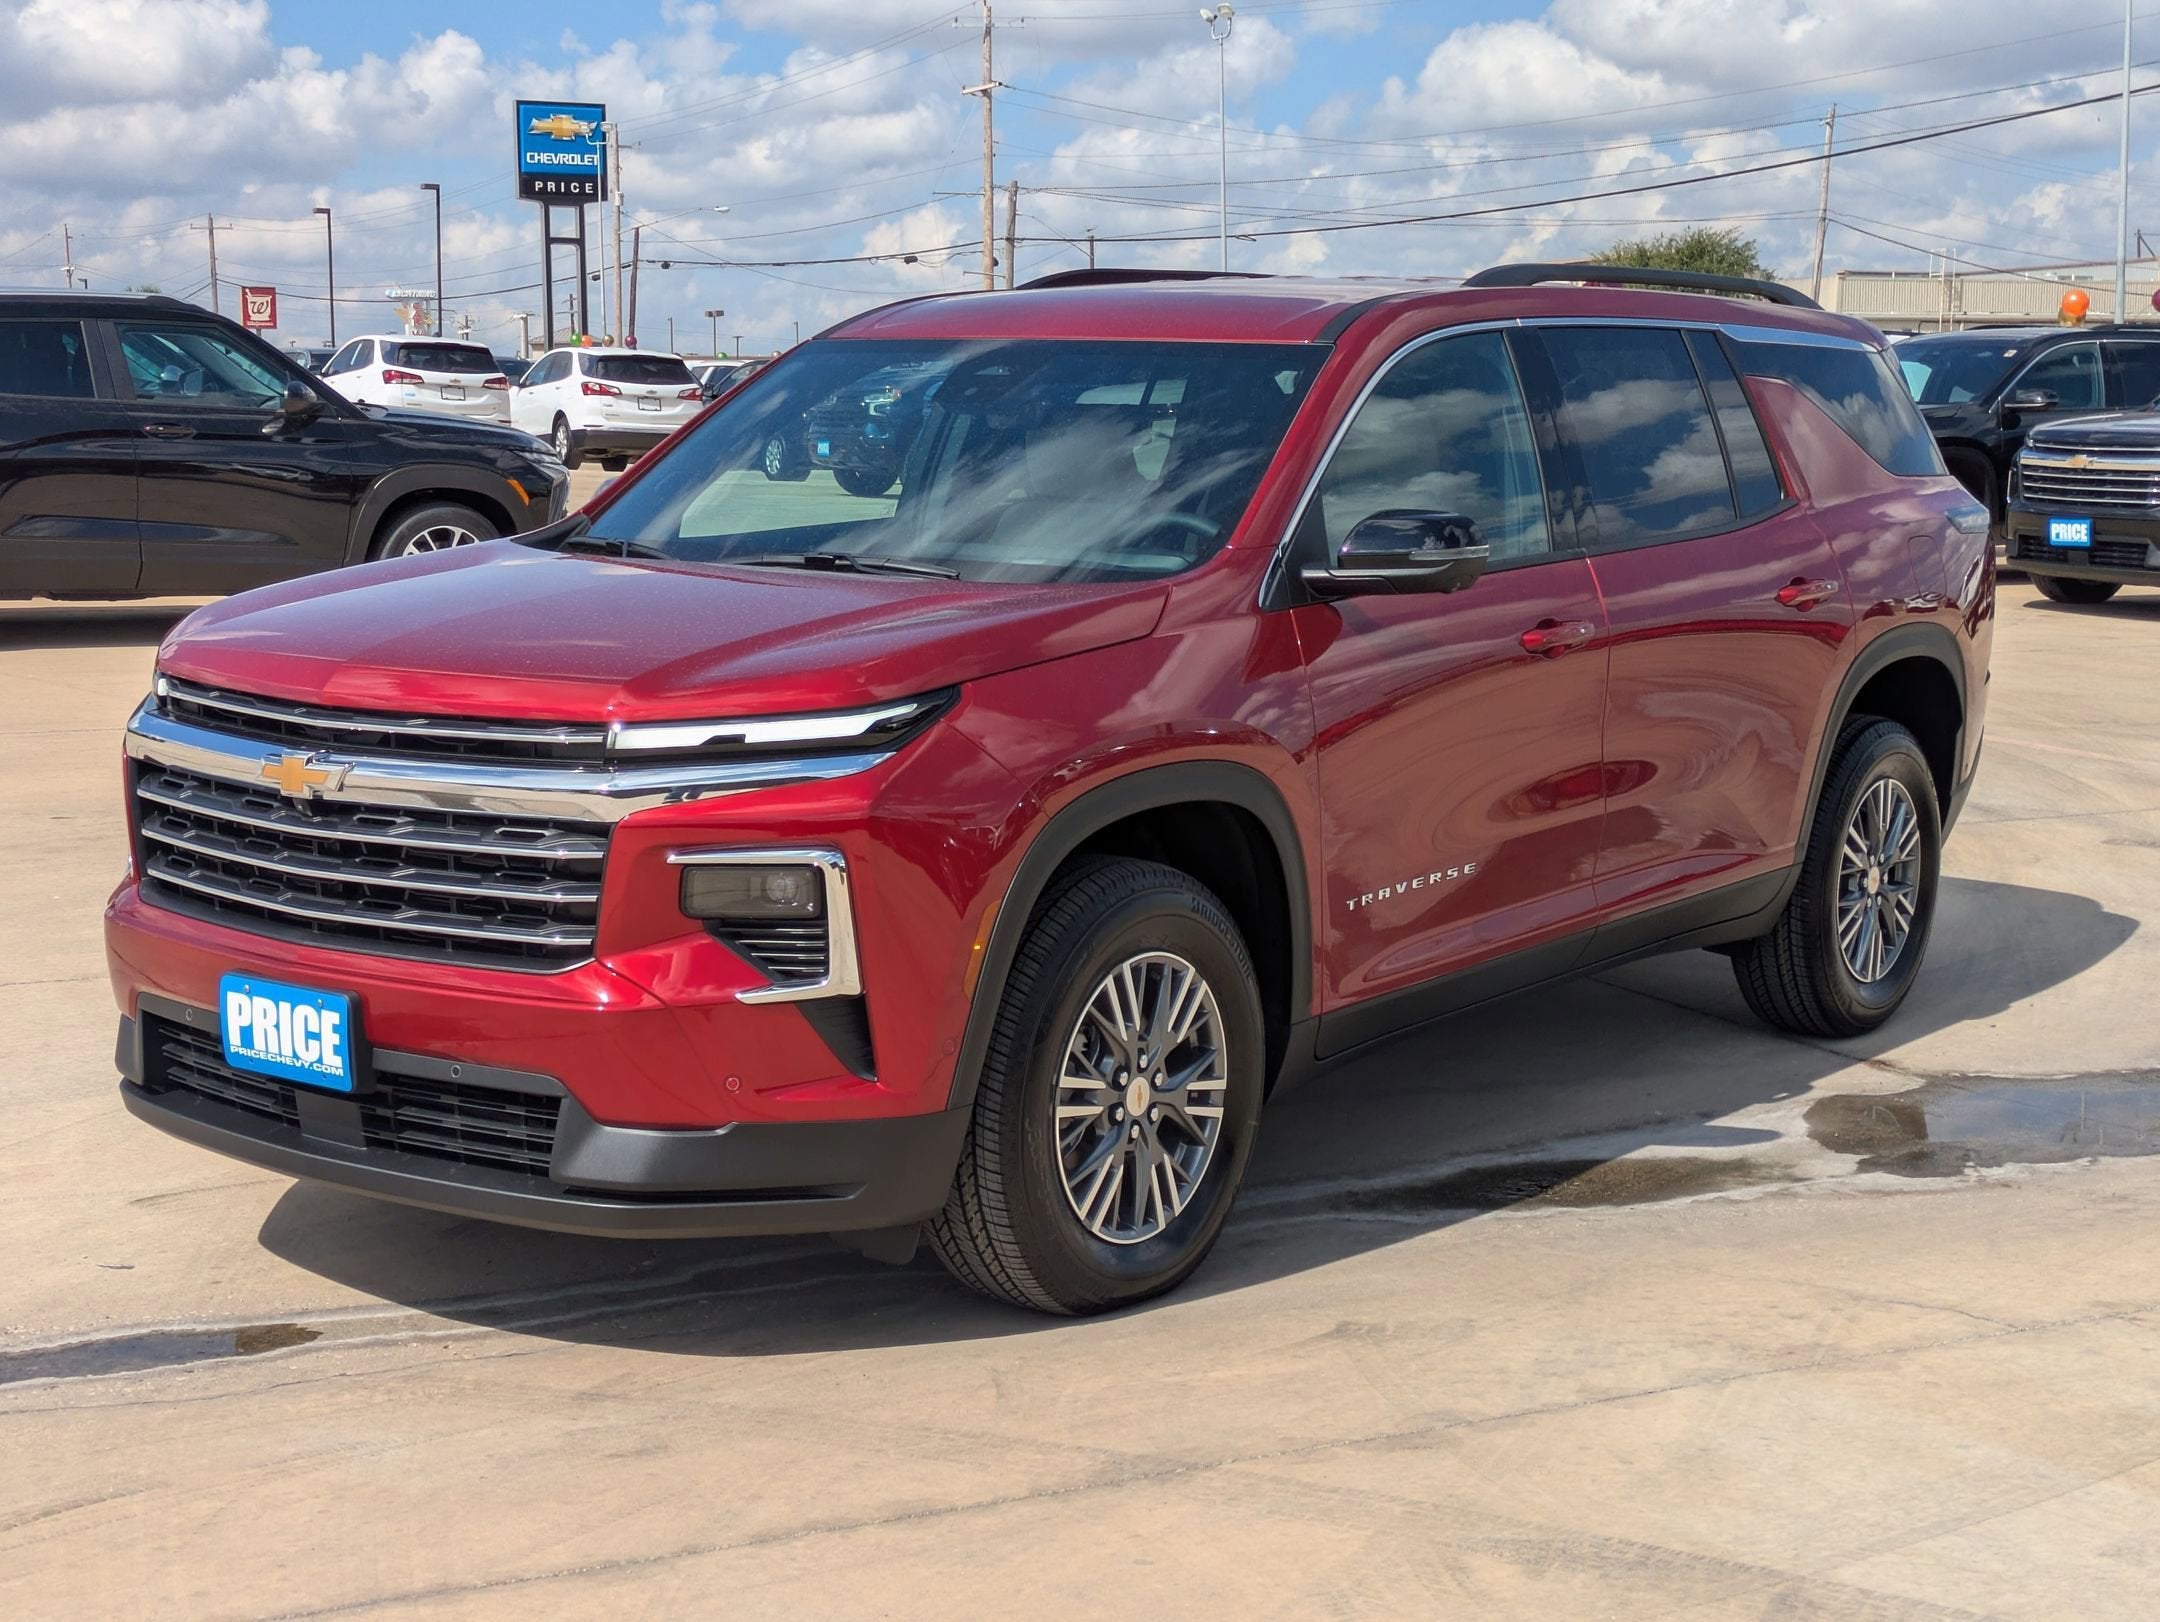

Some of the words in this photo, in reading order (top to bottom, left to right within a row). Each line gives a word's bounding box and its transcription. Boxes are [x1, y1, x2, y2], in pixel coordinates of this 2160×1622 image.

[526, 151, 599, 166] CHEVROLET
[535, 180, 594, 193] PRICE
[2051, 522, 2088, 540] PRICE
[1346, 862, 1477, 911] TRAVERSE
[226, 990, 343, 1068] PRICE
[229, 1044, 345, 1077] PRICECHEVY.COM
